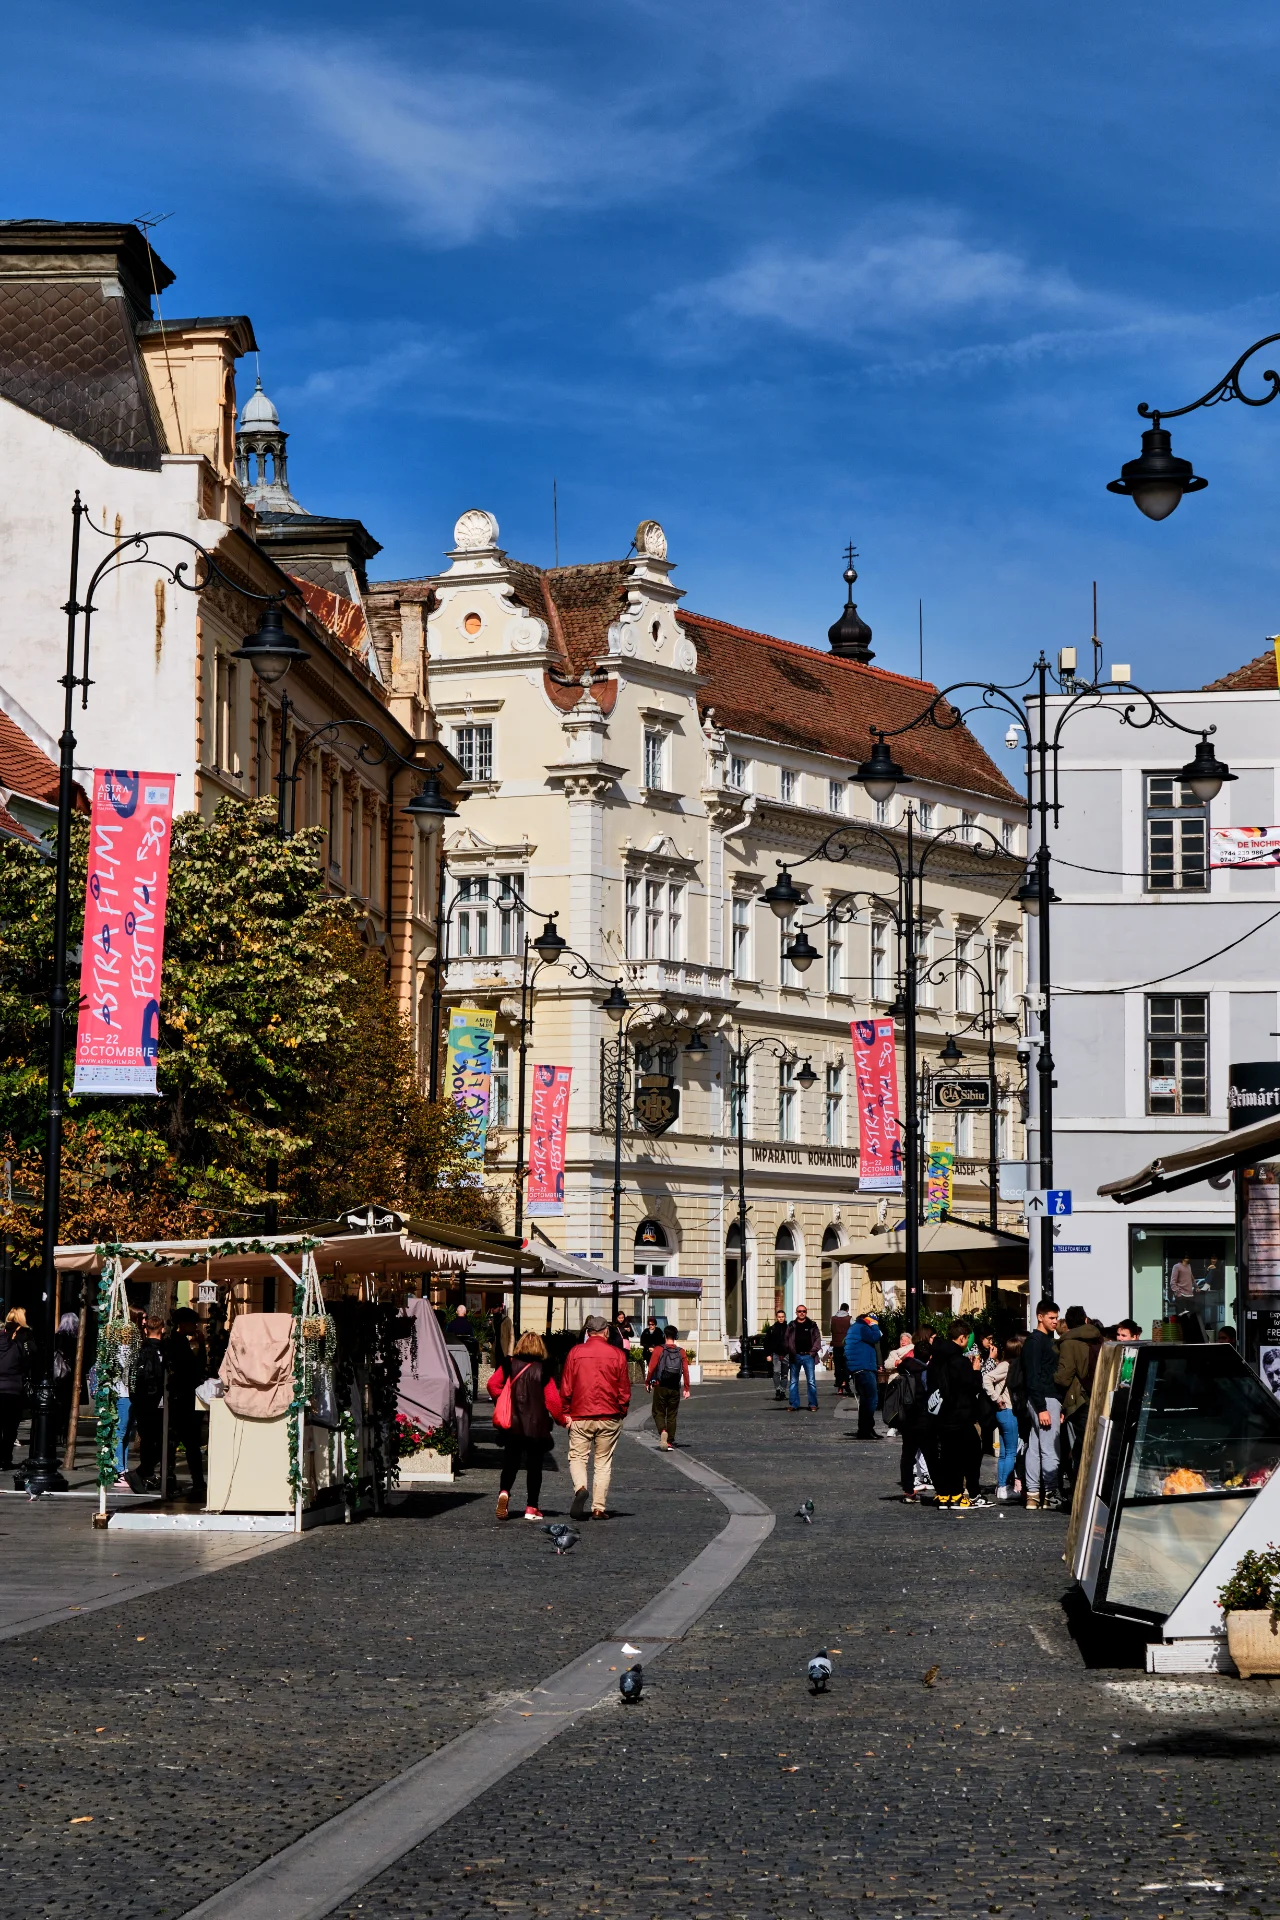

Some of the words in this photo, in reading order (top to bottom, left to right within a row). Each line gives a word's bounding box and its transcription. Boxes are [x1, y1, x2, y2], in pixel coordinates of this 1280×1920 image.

[97, 791, 121, 801] FILM
[98, 784, 129, 793] ASTRA
[94, 824, 124, 916] FILM
[129, 871, 157, 999] FESTIVAL
[92, 926, 123, 1029] ASTRA
[80, 1033, 91, 1044] 15
[106, 1034, 119, 1044] 22
[80, 1046, 154, 1057] OCTOMBRIE
[856, 1049, 877, 1098] FILM
[961, 1089, 985, 1100] Sibiu
[534, 1089, 548, 1133] FILM
[863, 1102, 883, 1158] ASTRA
[879, 1071, 897, 1140] FESTIVAL
[533, 1137, 548, 1186] ASTRA
[550, 1111, 563, 1171] FESTIVAL
[752, 1147, 802, 1165] IMPARATUL
[808, 1151, 857, 1168] ROMANILOR
[953, 1165, 975, 1176] AISER
